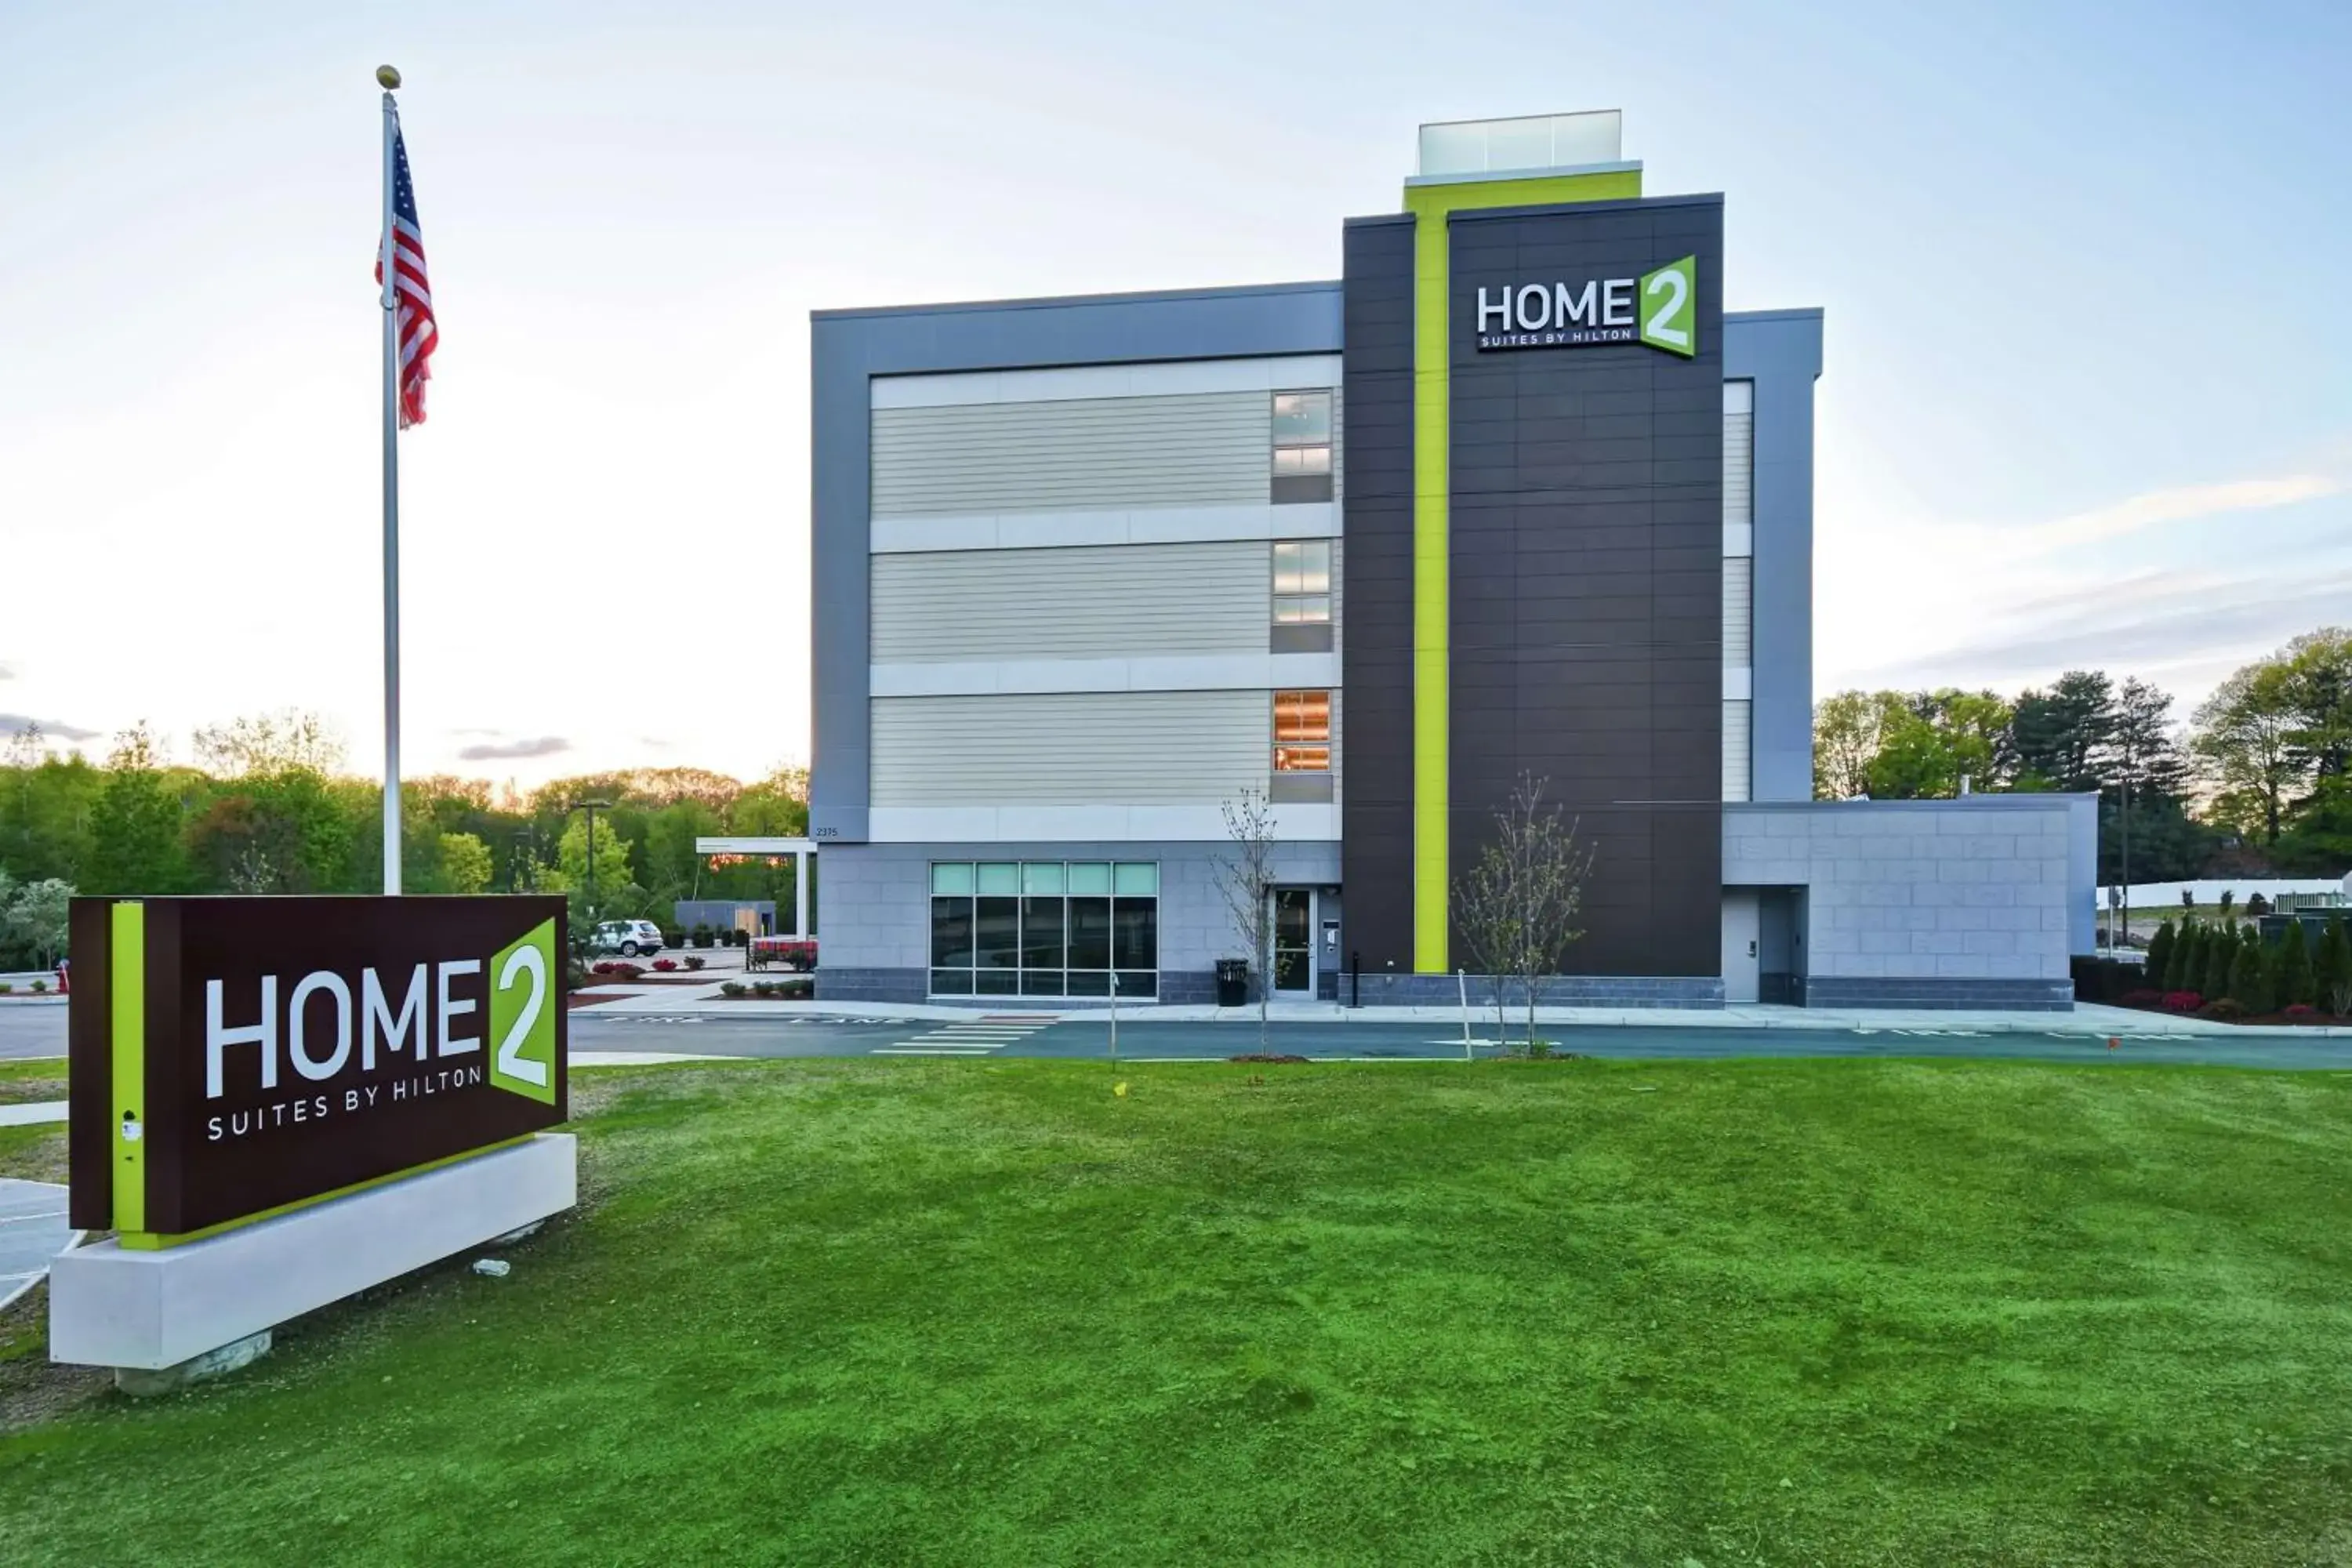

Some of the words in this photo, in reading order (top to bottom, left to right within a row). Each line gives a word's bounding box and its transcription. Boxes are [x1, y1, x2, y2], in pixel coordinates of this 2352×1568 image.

[1478, 278, 1634, 332] HOME
[1646, 269, 1688, 347] 2
[1481, 335, 1537, 347] SUITES
[1546, 333, 1564, 343] BY
[1573, 329, 1631, 341] HILTON
[206, 959, 481, 1098] HOME
[498, 945, 546, 1087] 2
[208, 1096, 328, 1140] SUITES
[346, 1087, 379, 1111] BY
[394, 1065, 481, 1101] HILTON
